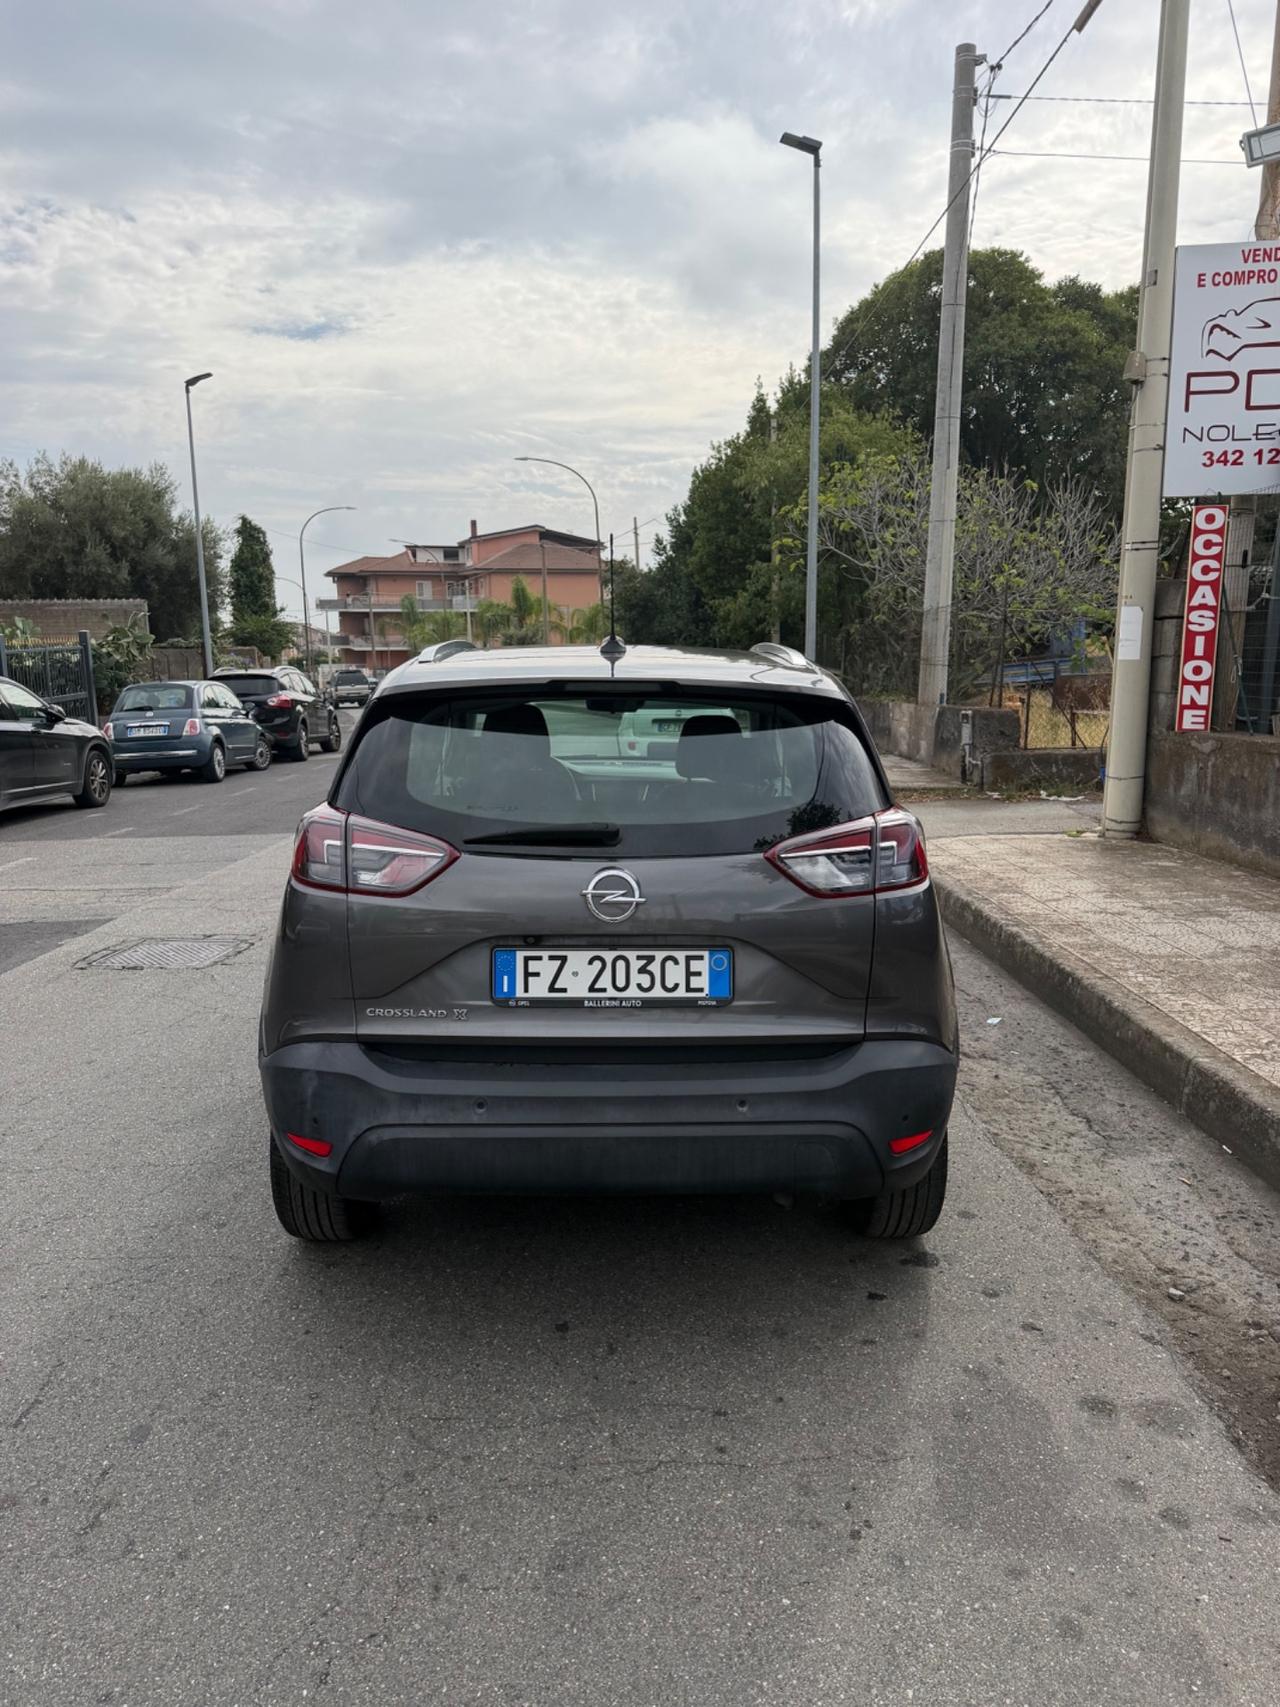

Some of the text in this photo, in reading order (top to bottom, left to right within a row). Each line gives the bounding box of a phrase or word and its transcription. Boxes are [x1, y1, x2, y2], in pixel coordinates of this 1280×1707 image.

[1197, 268, 1278, 288] E COMPRO
[1202, 448, 1280, 468] 342 12
[1181, 508, 1226, 730] OCCASIONE
[523, 955, 568, 993] FZ
[588, 955, 705, 993] 203CE
[366, 1007, 468, 1020] CROSSLAND X
